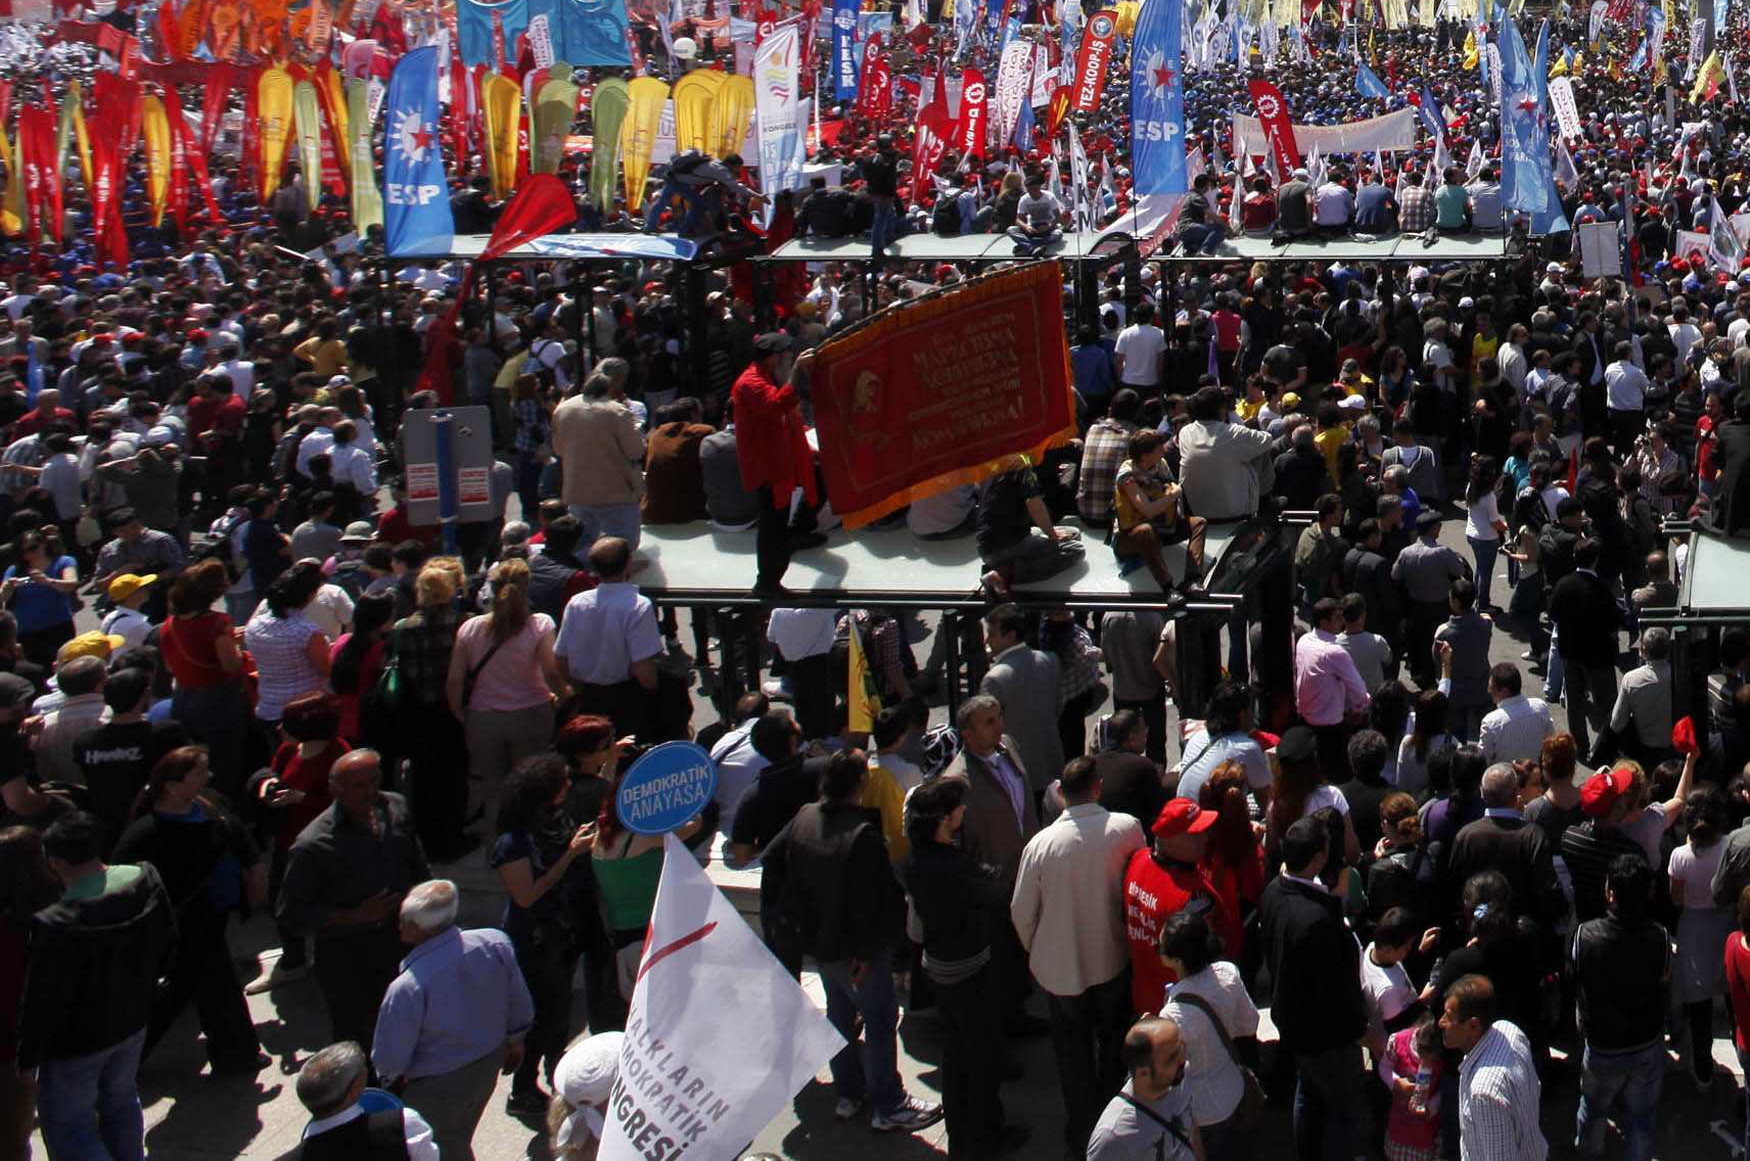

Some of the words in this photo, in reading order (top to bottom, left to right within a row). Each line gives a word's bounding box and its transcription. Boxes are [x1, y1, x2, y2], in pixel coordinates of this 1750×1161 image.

[1079, 40, 1107, 107] TEZ-KOOP-İŞ
[1134, 120, 1179, 141] ESP
[386, 184, 440, 205] ESP
[623, 765, 709, 805] DEMOKRATİK
[630, 782, 705, 822] ANAYASA
[619, 1033, 708, 1144] MOKRATİK
[606, 1066, 690, 1161] NGRESİ
